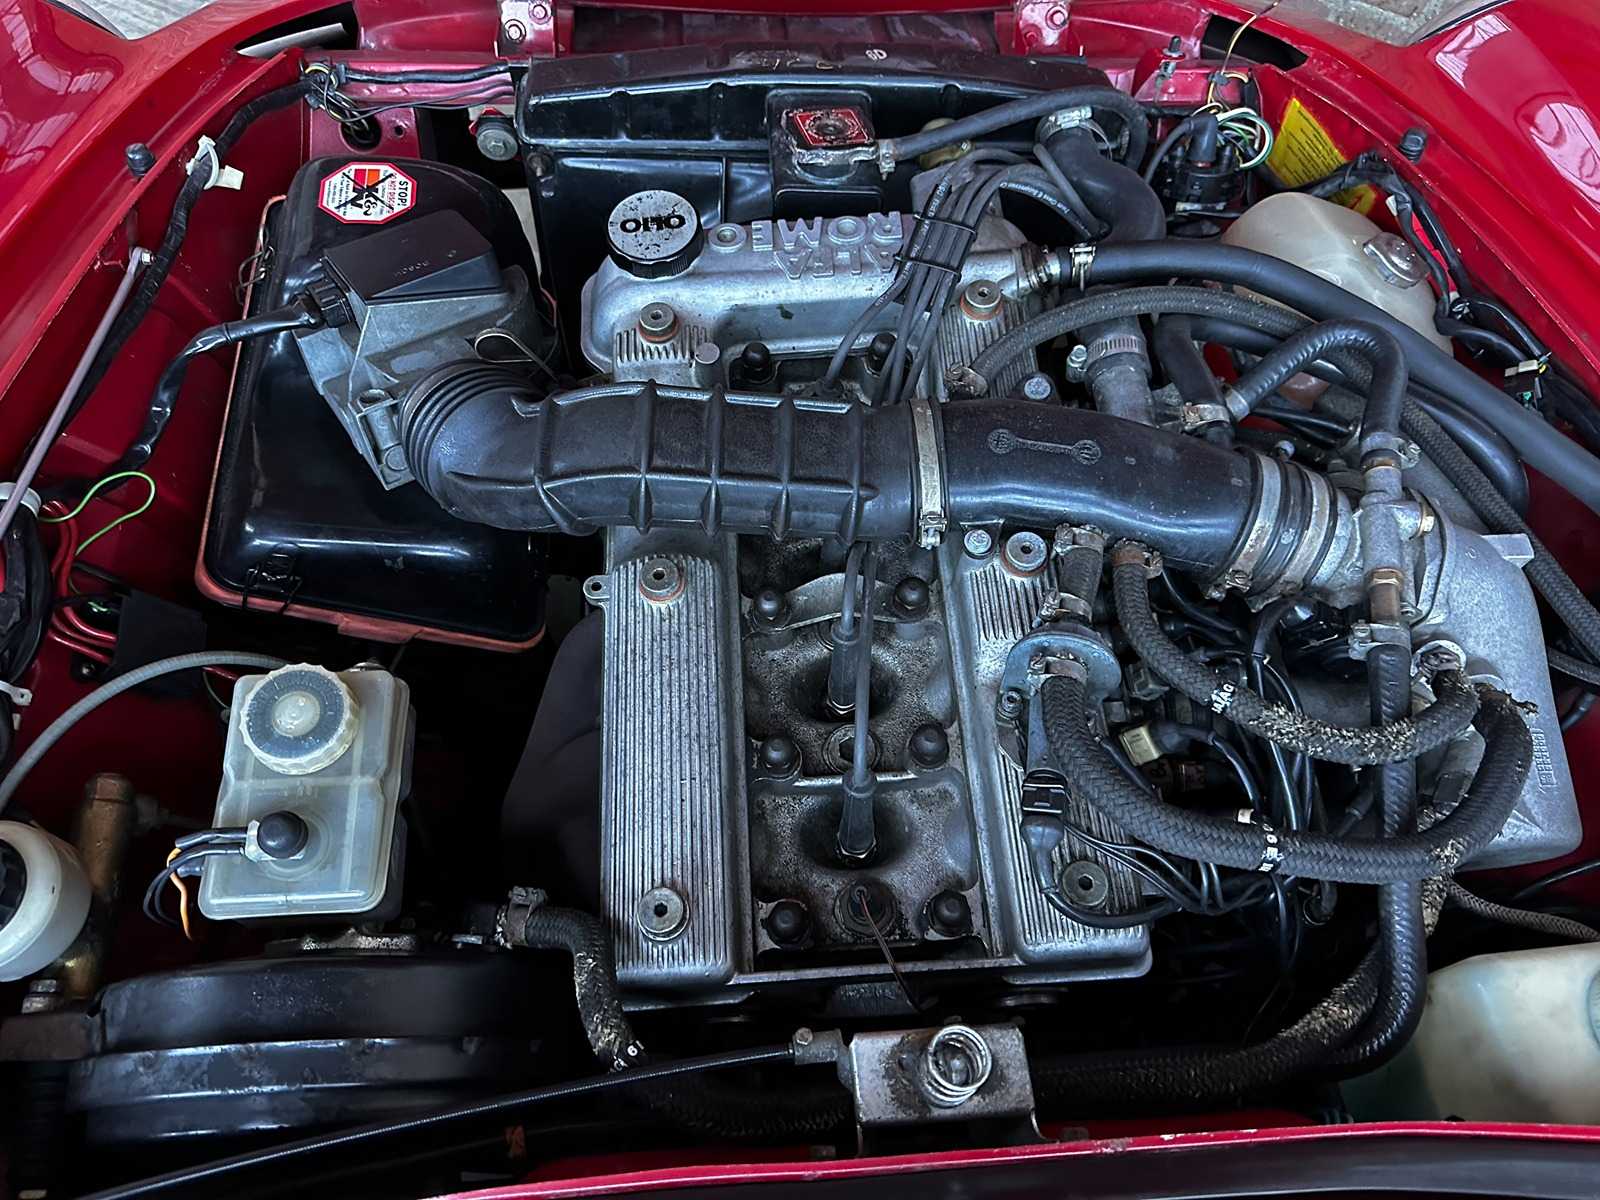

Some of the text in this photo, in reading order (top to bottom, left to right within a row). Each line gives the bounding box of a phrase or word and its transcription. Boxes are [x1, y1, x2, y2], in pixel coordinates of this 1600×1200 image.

[398, 180, 409, 207] STOP!
[619, 214, 686, 234] OLIO
[708, 211, 904, 253] ROMEO
[774, 244, 895, 280] ALFA
